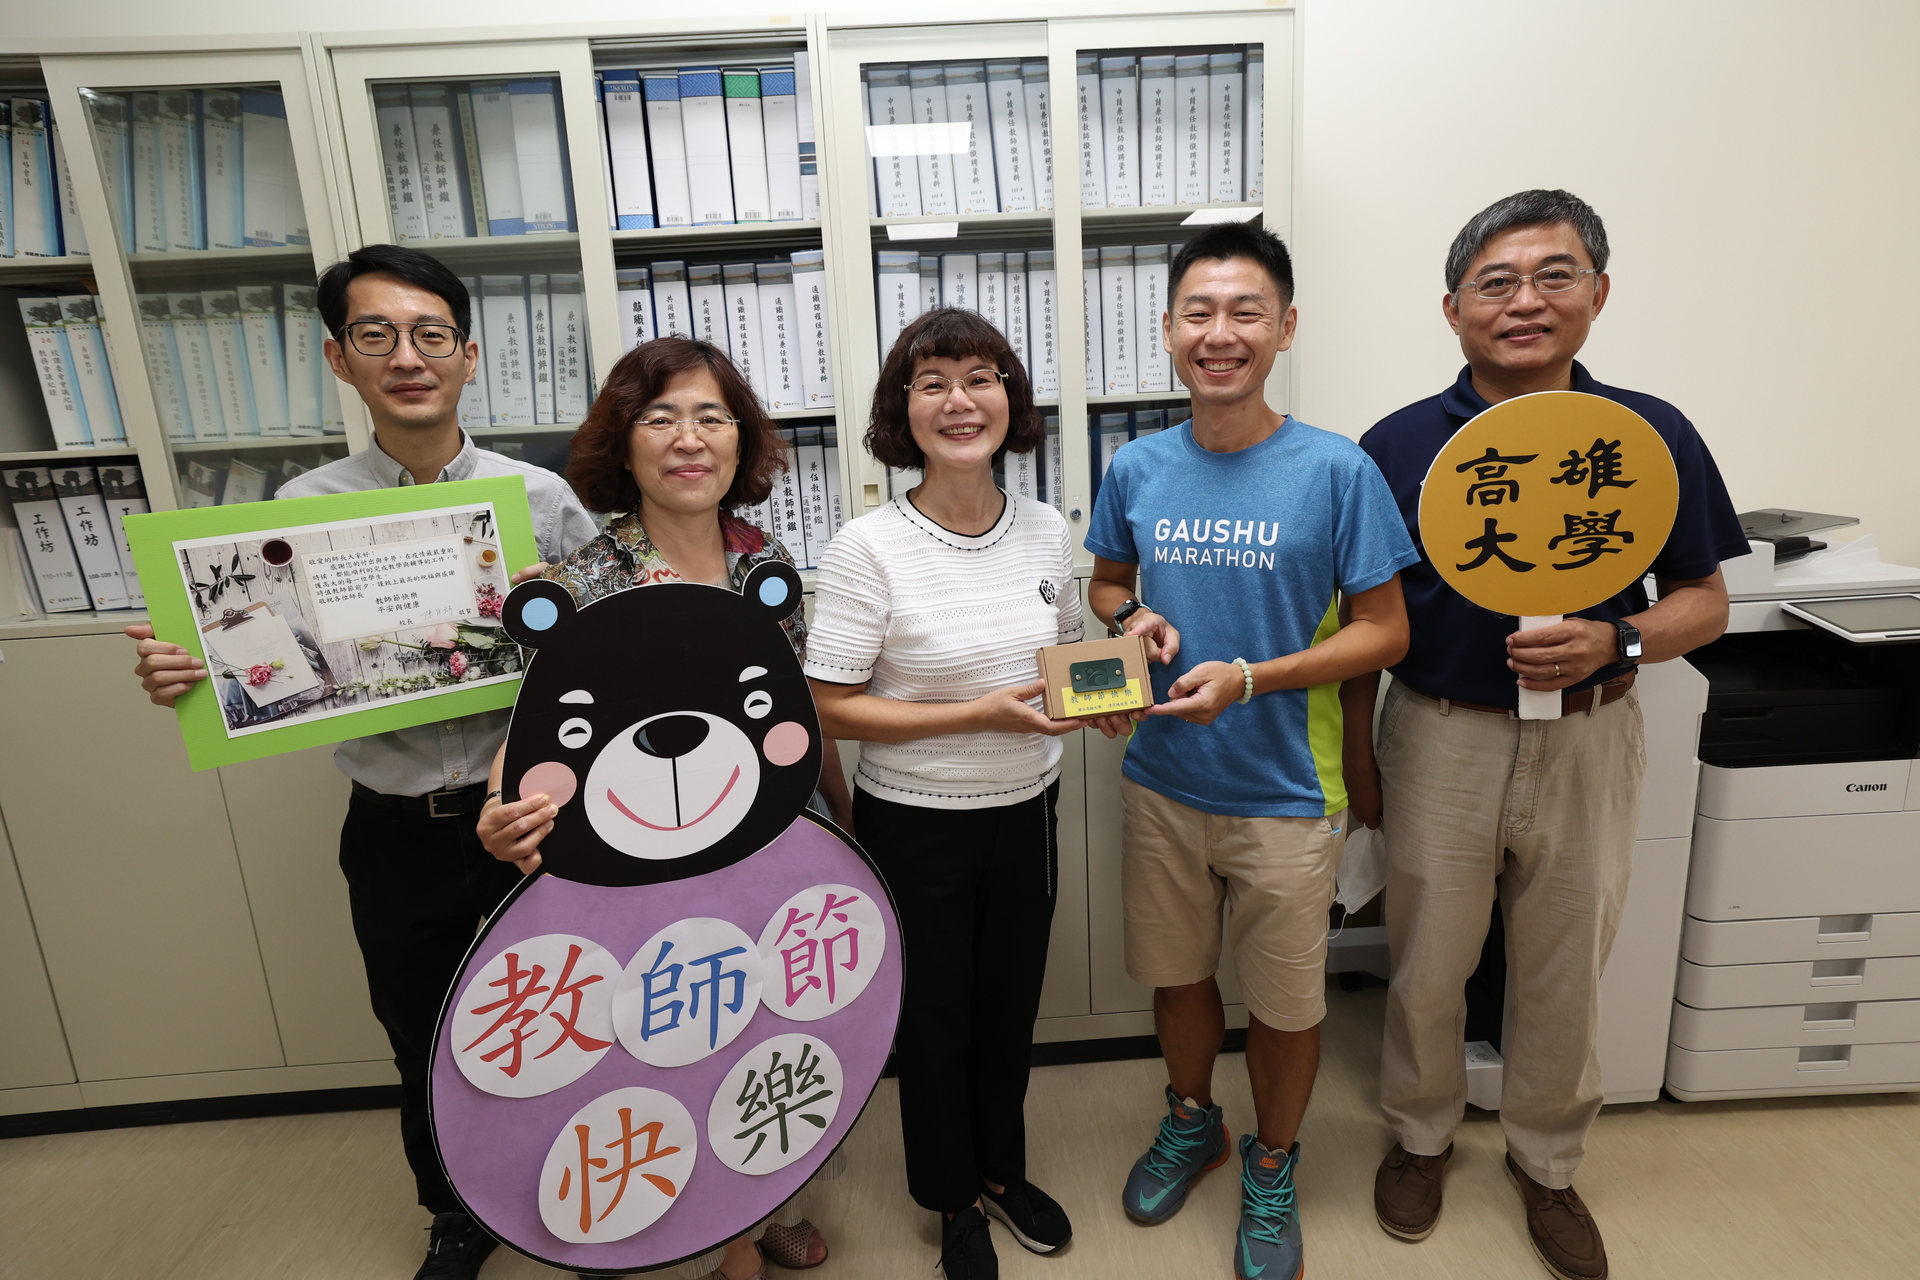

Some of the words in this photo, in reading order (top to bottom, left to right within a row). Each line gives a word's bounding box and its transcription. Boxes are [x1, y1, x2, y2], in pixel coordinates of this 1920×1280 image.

[1006, 90, 1021, 182] 申請兼任教師擬聘資料
[1080, 85, 1092, 178] 申請兼任教師擬聘資料
[1116, 88, 1126, 180] 申請兼任教師擬聘資料
[1155, 88, 1163, 180] 申請兼任教師擬聘資料
[1189, 86, 1198, 178] 申請兼任教師擬聘資料
[1223, 84, 1231, 176] 申請兼任教師擬聘資料
[392, 123, 414, 203] 兼任教師評鑑
[422, 162, 435, 214] (共同課程組)
[431, 123, 450, 203] 兼任教師評鑑
[533, 222, 556, 230] STRONG
[506, 312, 522, 380] 兼任教師評鑑
[535, 309, 549, 384] 兼任教師評鑑
[567, 310, 578, 378] 兼任教師評鑑
[774, 297, 790, 392] 通識課程組兼任教師資料
[811, 285, 828, 384] 通識課程組兼任教師資料
[1044, 280, 1054, 365] 申請兼任教師擬聘資料
[1116, 275, 1126, 361] 申請兼任教師擬聘資料
[1149, 274, 1158, 360] 申請兼任教師擬聘資料
[499, 348, 510, 398] (通識課程組)
[558, 346, 567, 395] (通識課程組)
[782, 469, 798, 532] 任教師評鑑
[810, 461, 824, 524] 兼任教師評鑑
[1456, 438, 1638, 506] 高雄
[33, 514, 54, 553] 工作坊
[76, 506, 99, 546] 工作坊
[772, 497, 784, 542] (共同課程組)
[803, 496, 813, 541] (通識課程組)
[1154, 518, 1280, 546] GAUSHU
[1456, 509, 1634, 572] 大學
[1154, 546, 1275, 570] MARATHON
[318, 593, 364, 604] 敬祝各位師長
[376, 592, 418, 605] 教師節快樂
[377, 602, 420, 614] 平安與健康
[399, 618, 414, 626] 校長
[1070, 688, 1132, 704] 教師節快樂
[1846, 784, 1888, 792] Canon
[462, 894, 859, 1078] 教師節
[558, 1044, 834, 1234] 快樂
[1261, 1156, 1279, 1164] NIKE
